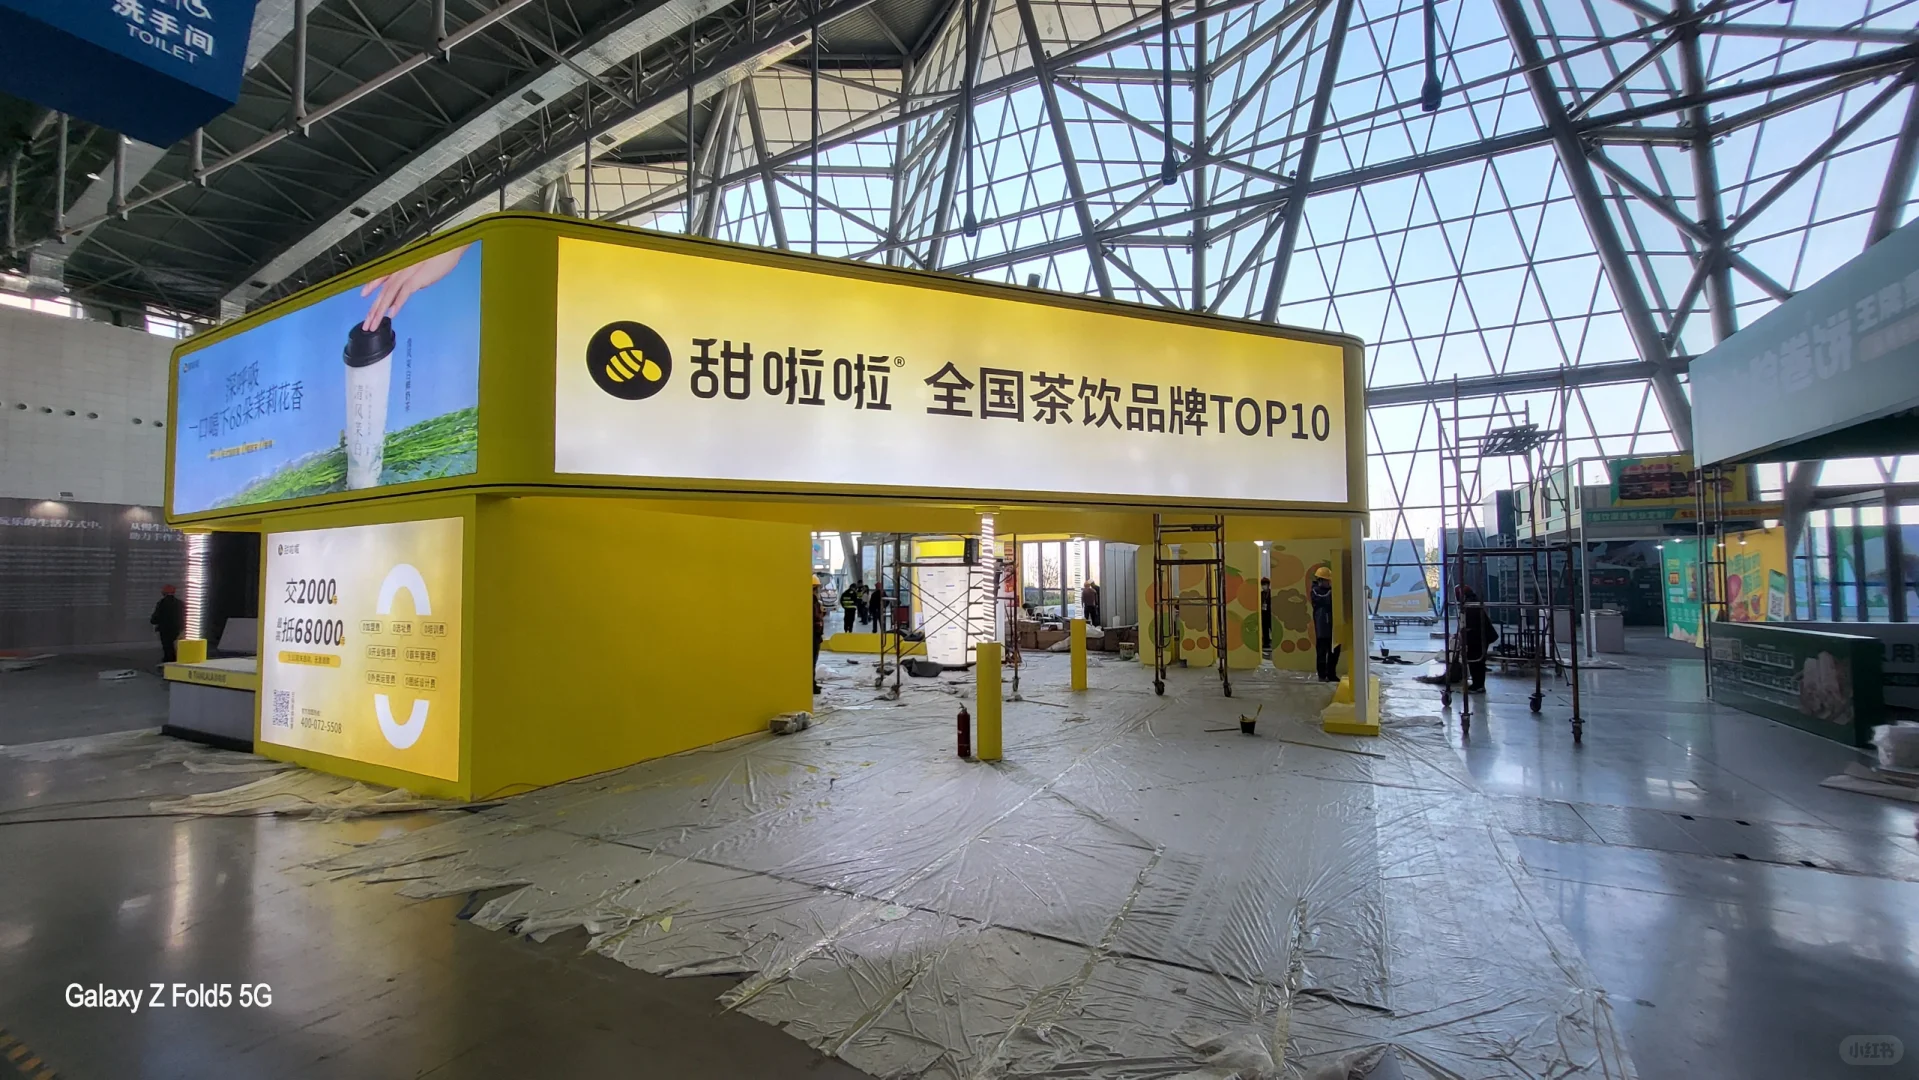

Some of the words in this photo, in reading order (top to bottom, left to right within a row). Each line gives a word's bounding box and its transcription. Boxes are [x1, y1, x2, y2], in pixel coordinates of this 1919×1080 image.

[111, 0, 214, 56] 洗手间
[126, 23, 198, 64] TOILET
[923, 361, 1330, 442] 全国茶饮品牌TOP10
[301, 717, 343, 734] 400-072-5508
